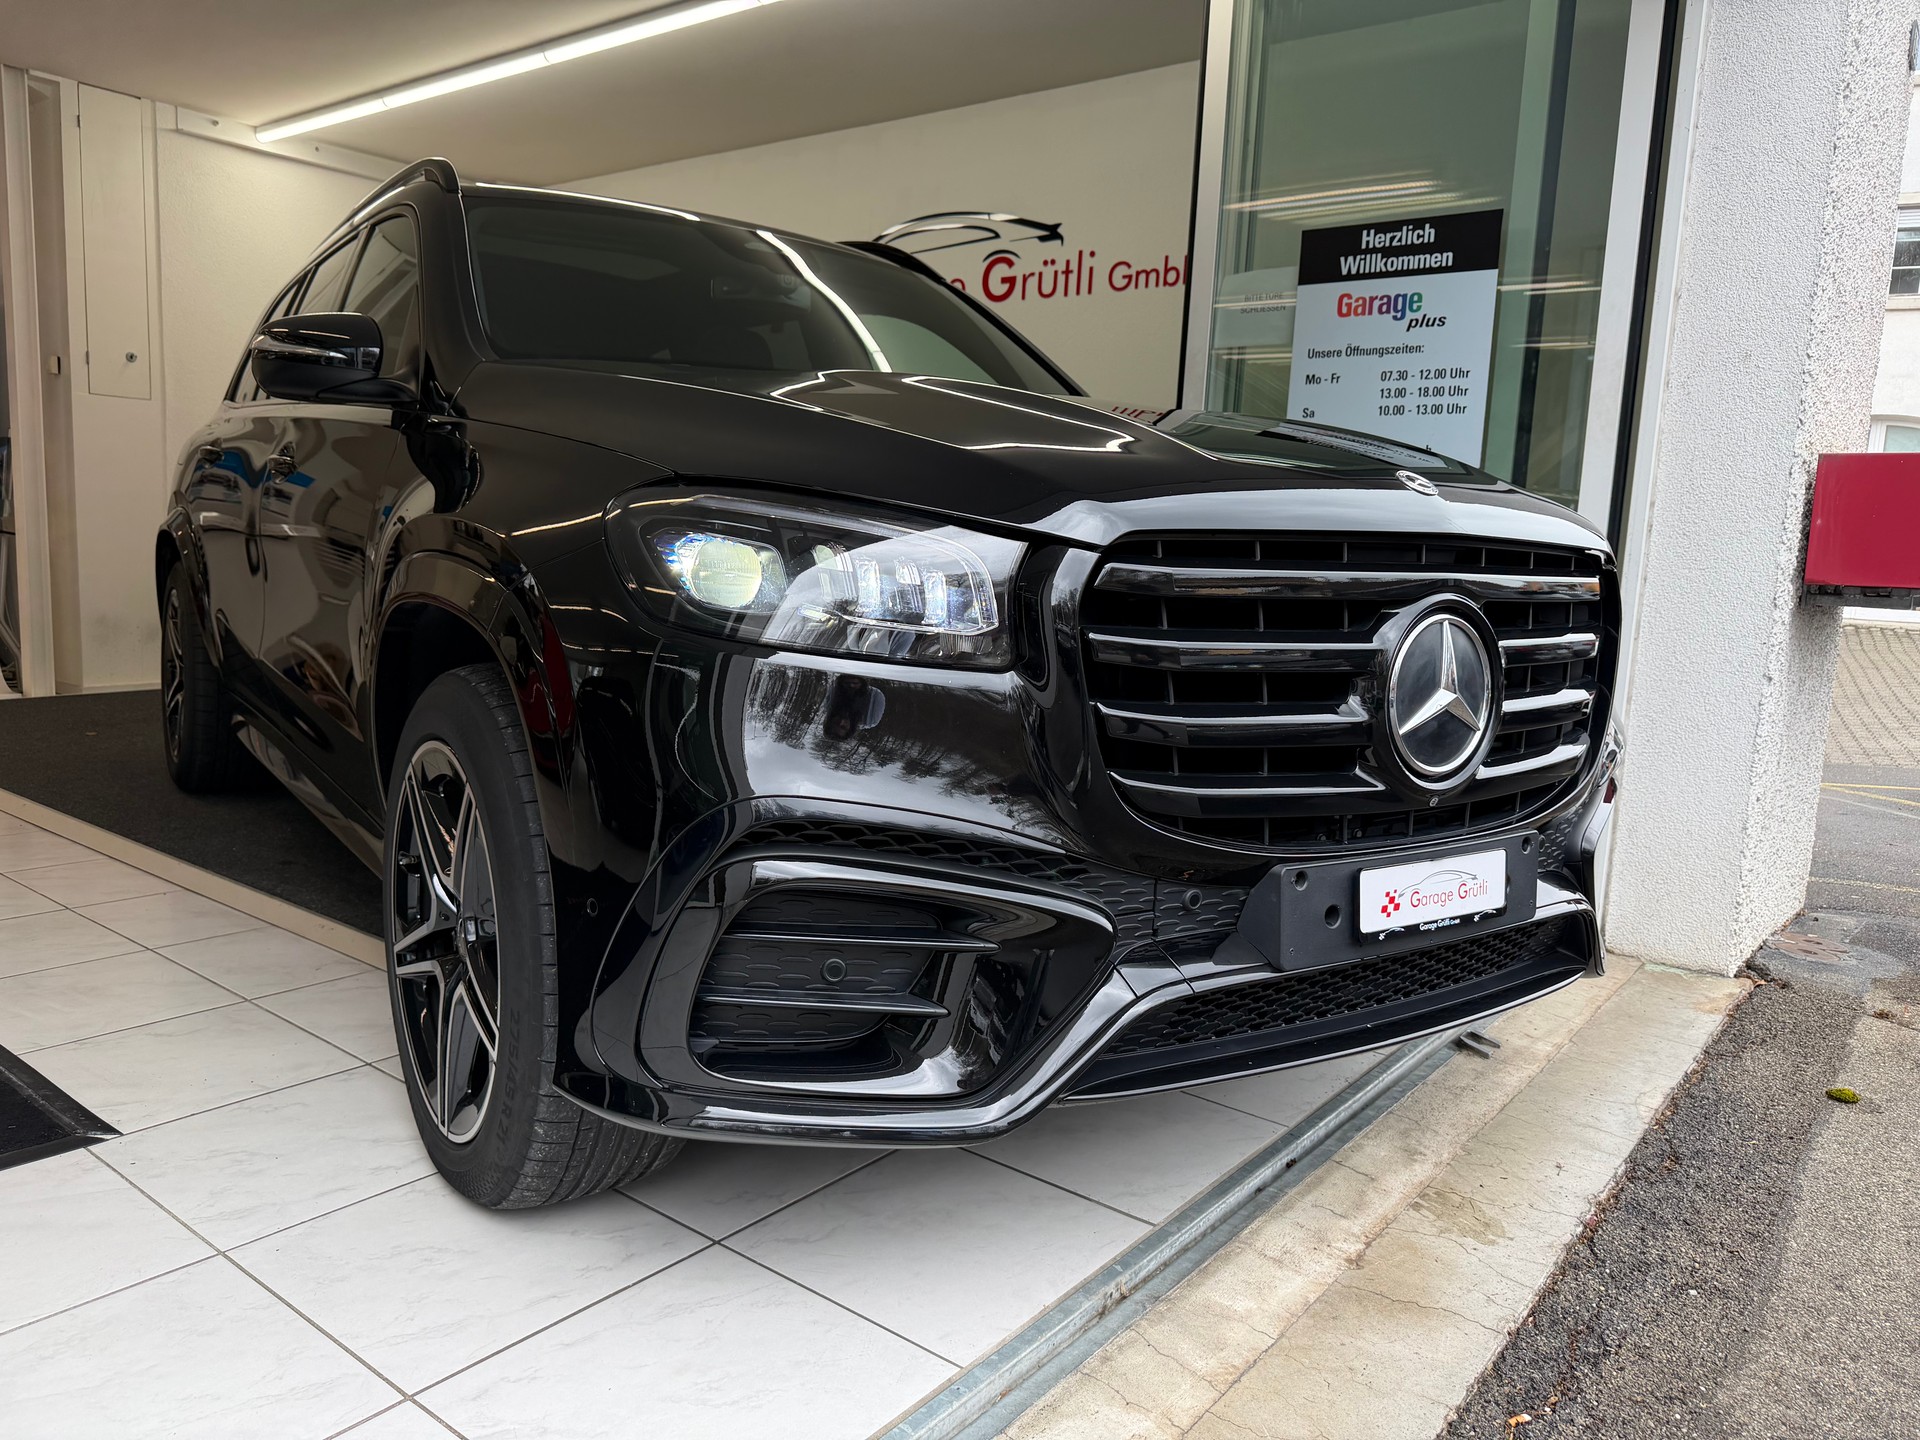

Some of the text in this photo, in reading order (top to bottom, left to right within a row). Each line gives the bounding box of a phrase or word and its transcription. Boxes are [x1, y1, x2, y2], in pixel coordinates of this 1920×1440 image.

[1361, 223, 1435, 249] Herzlich
[1339, 250, 1454, 276] Willkommen
[982, 250, 1096, 302] Grütli
[1337, 291, 1423, 321] Garage
[1406, 313, 1447, 332] plus
[1307, 343, 1425, 360] Unsere Öffnungszeiten:
[1305, 374, 1322, 385] Mo
[1331, 373, 1341, 385] Fr
[1380, 370, 1408, 382] 07.30
[1419, 369, 1447, 381] 12.00
[1450, 368, 1471, 380] Uhr
[1379, 387, 1407, 399] 13.00
[1417, 386, 1445, 398] 18.00
[1448, 385, 1469, 397] Uhr
[1302, 408, 1315, 419] Sa
[1378, 405, 1405, 417] 10.00
[1416, 404, 1444, 416] 13.00
[1446, 403, 1467, 415] Uhr
[1410, 879, 1488, 908] Garage Grütli
[504, 1008, 520, 1101] 275/45
